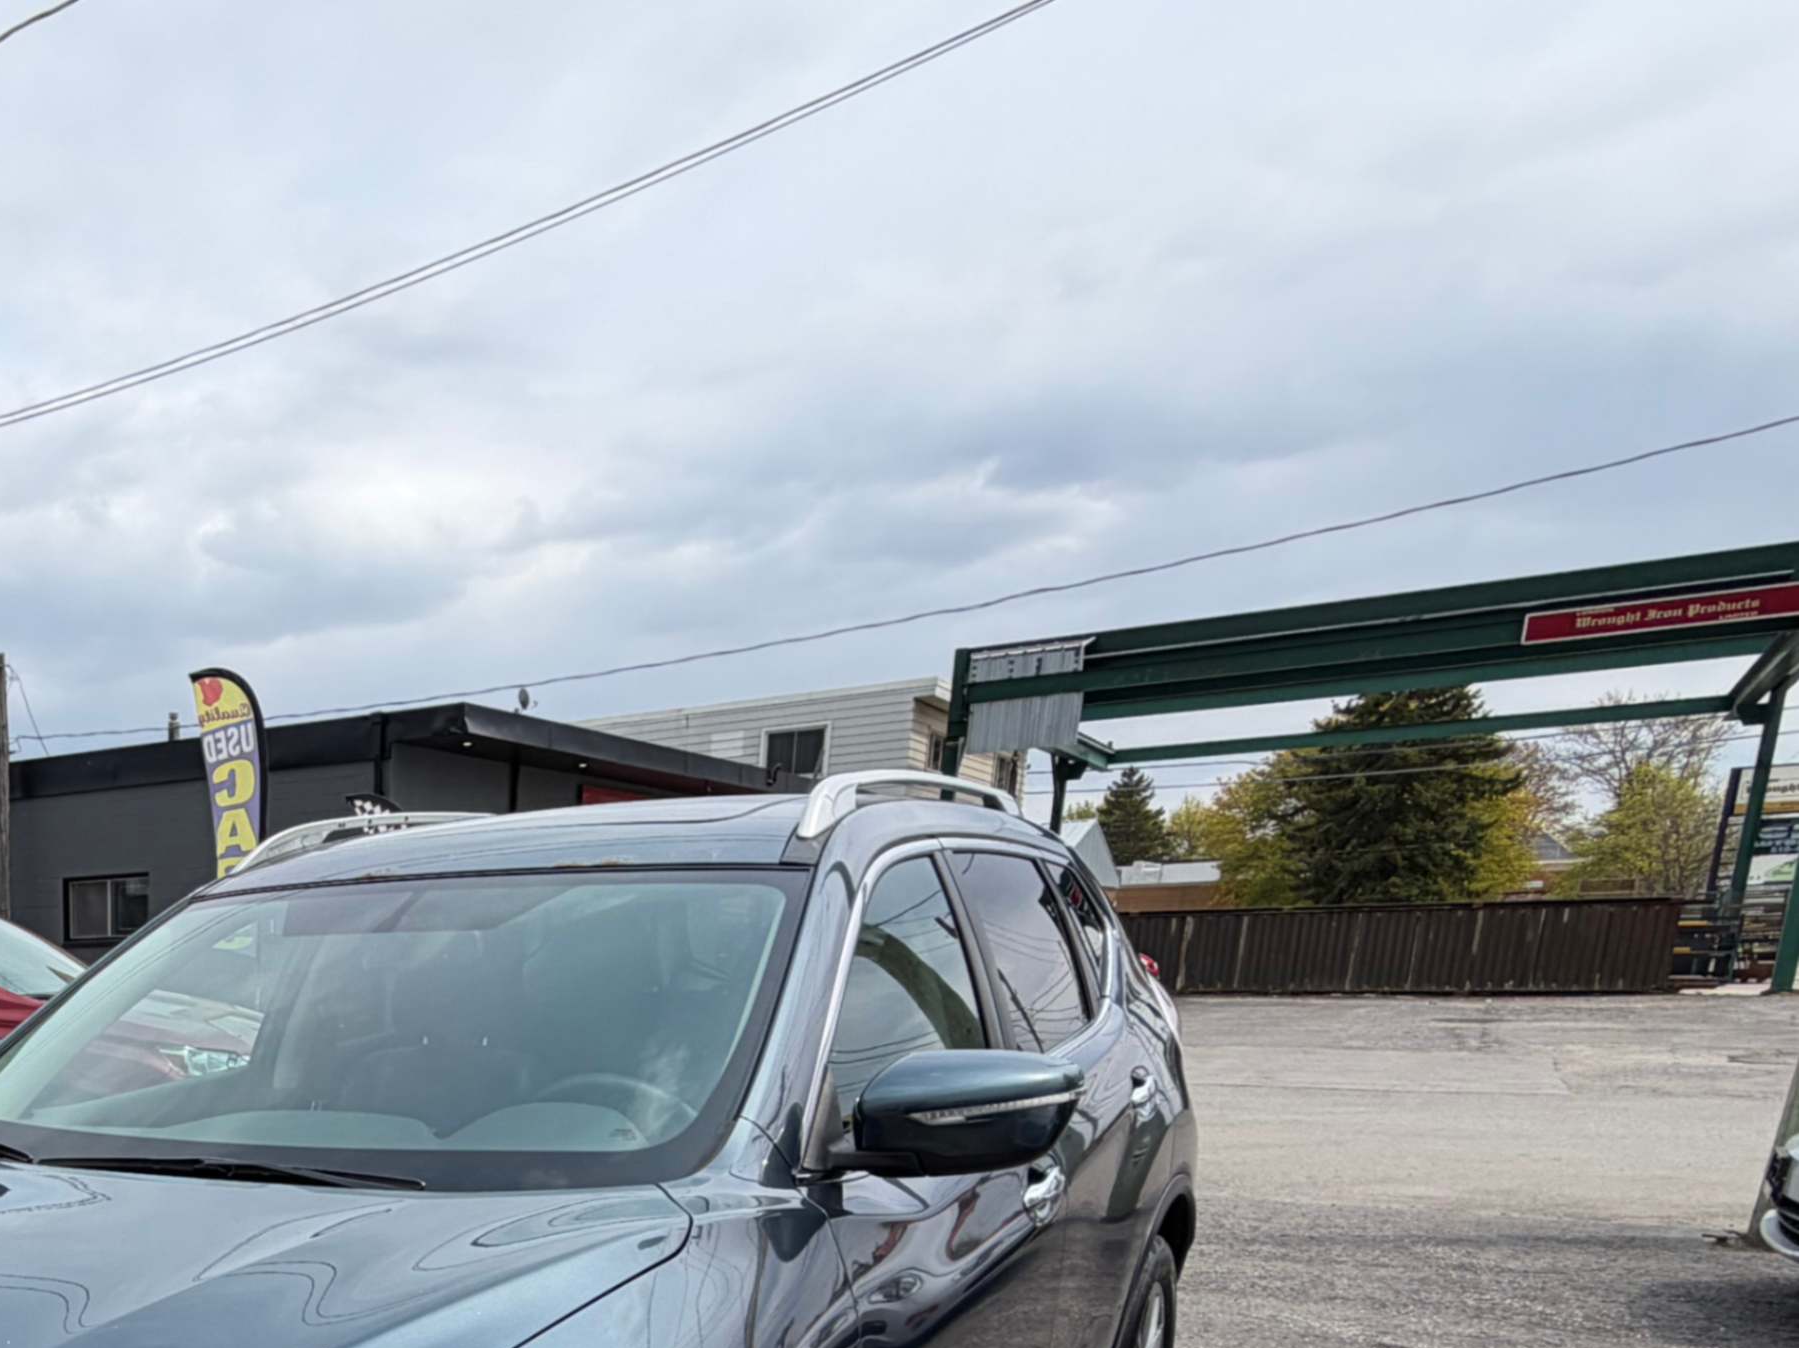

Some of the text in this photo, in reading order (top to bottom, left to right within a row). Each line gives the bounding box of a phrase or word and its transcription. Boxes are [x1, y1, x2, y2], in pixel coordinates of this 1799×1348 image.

[1575, 611, 1641, 629] Wrought
[1643, 606, 1682, 621] Iron
[1687, 598, 1761, 618] Products
